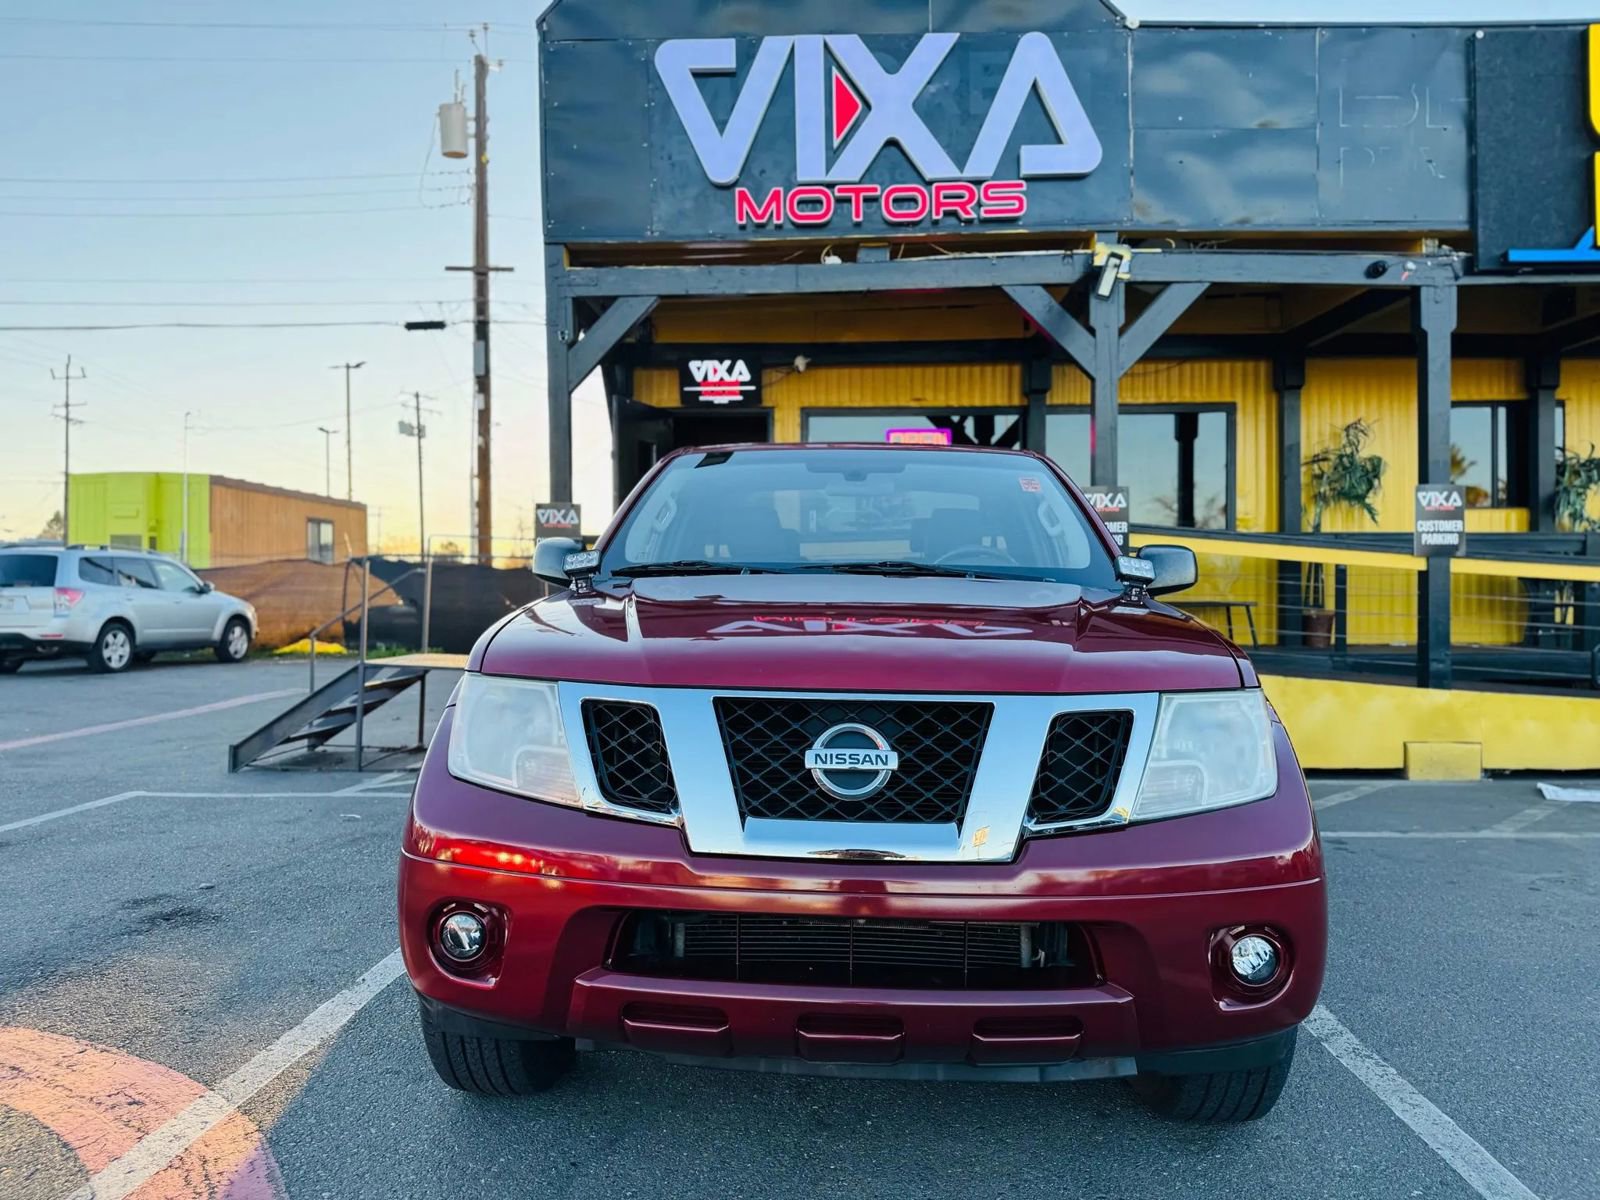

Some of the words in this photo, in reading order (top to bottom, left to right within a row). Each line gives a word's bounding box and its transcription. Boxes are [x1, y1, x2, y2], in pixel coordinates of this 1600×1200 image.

[654, 31, 1103, 186] VIXA
[735, 180, 1028, 224] MOTORS
[688, 359, 752, 382] VIXA
[1417, 491, 1463, 507] VIXA
[536, 509, 580, 524] VIXA
[1417, 520, 1463, 532] CUSTOMER
[1421, 533, 1459, 545] PARKING
[814, 753, 889, 766] NISSAN
